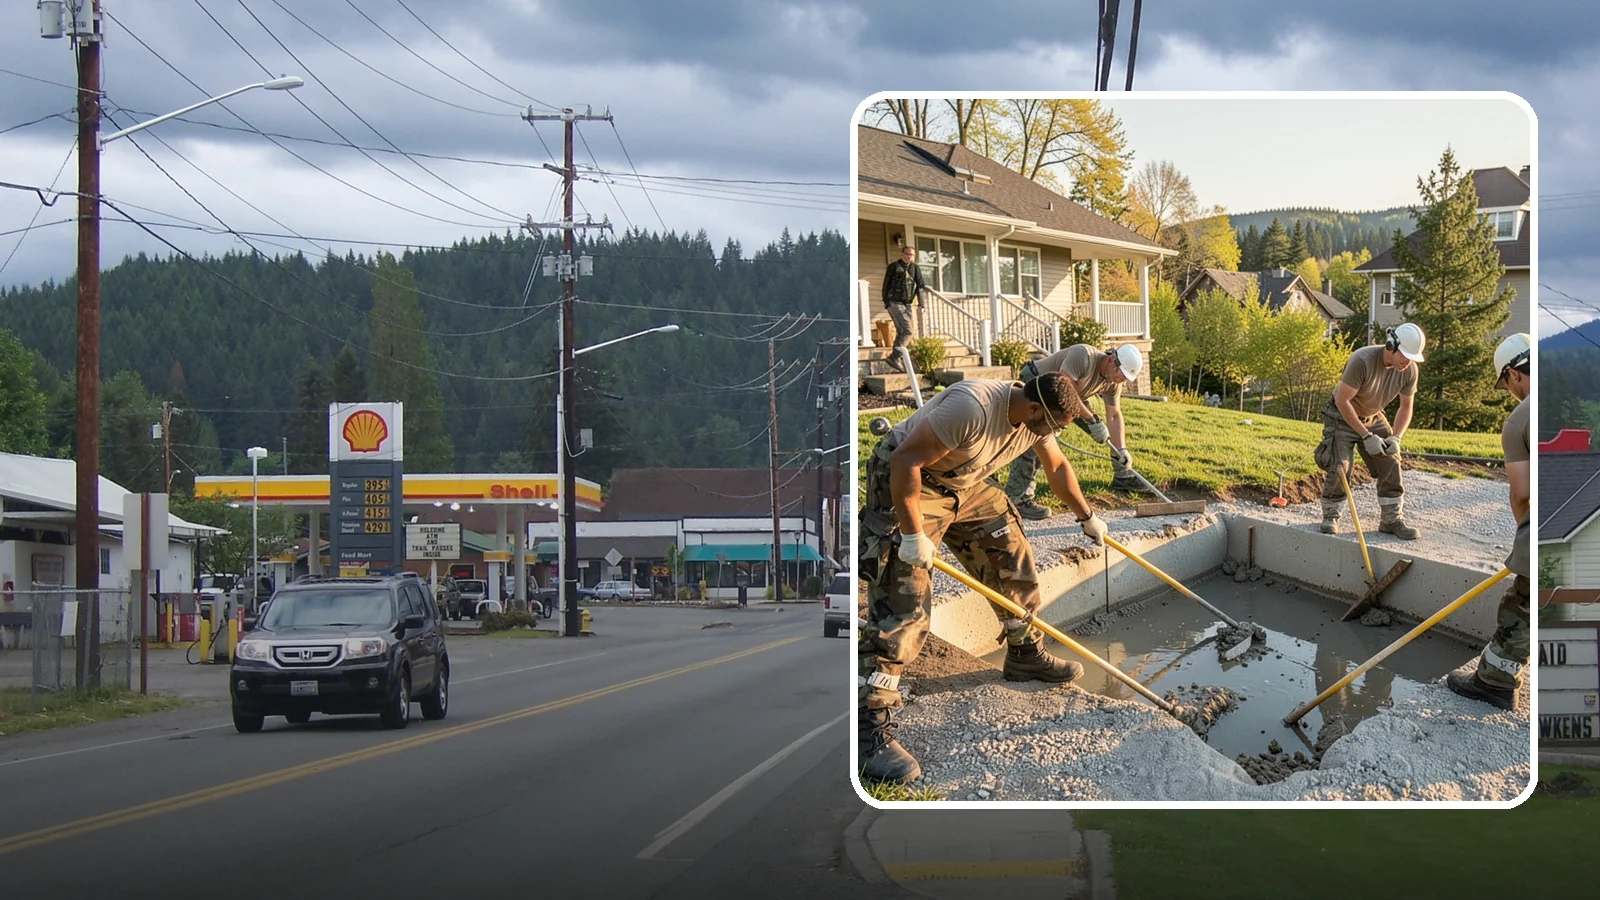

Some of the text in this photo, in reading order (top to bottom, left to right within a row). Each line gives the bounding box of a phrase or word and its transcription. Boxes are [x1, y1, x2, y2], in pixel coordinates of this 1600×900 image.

[366, 480, 383, 490] 395
[490, 484, 547, 499] Shell
[366, 494, 383, 504] 405
[366, 508, 383, 518] 415
[366, 522, 383, 533] 429
